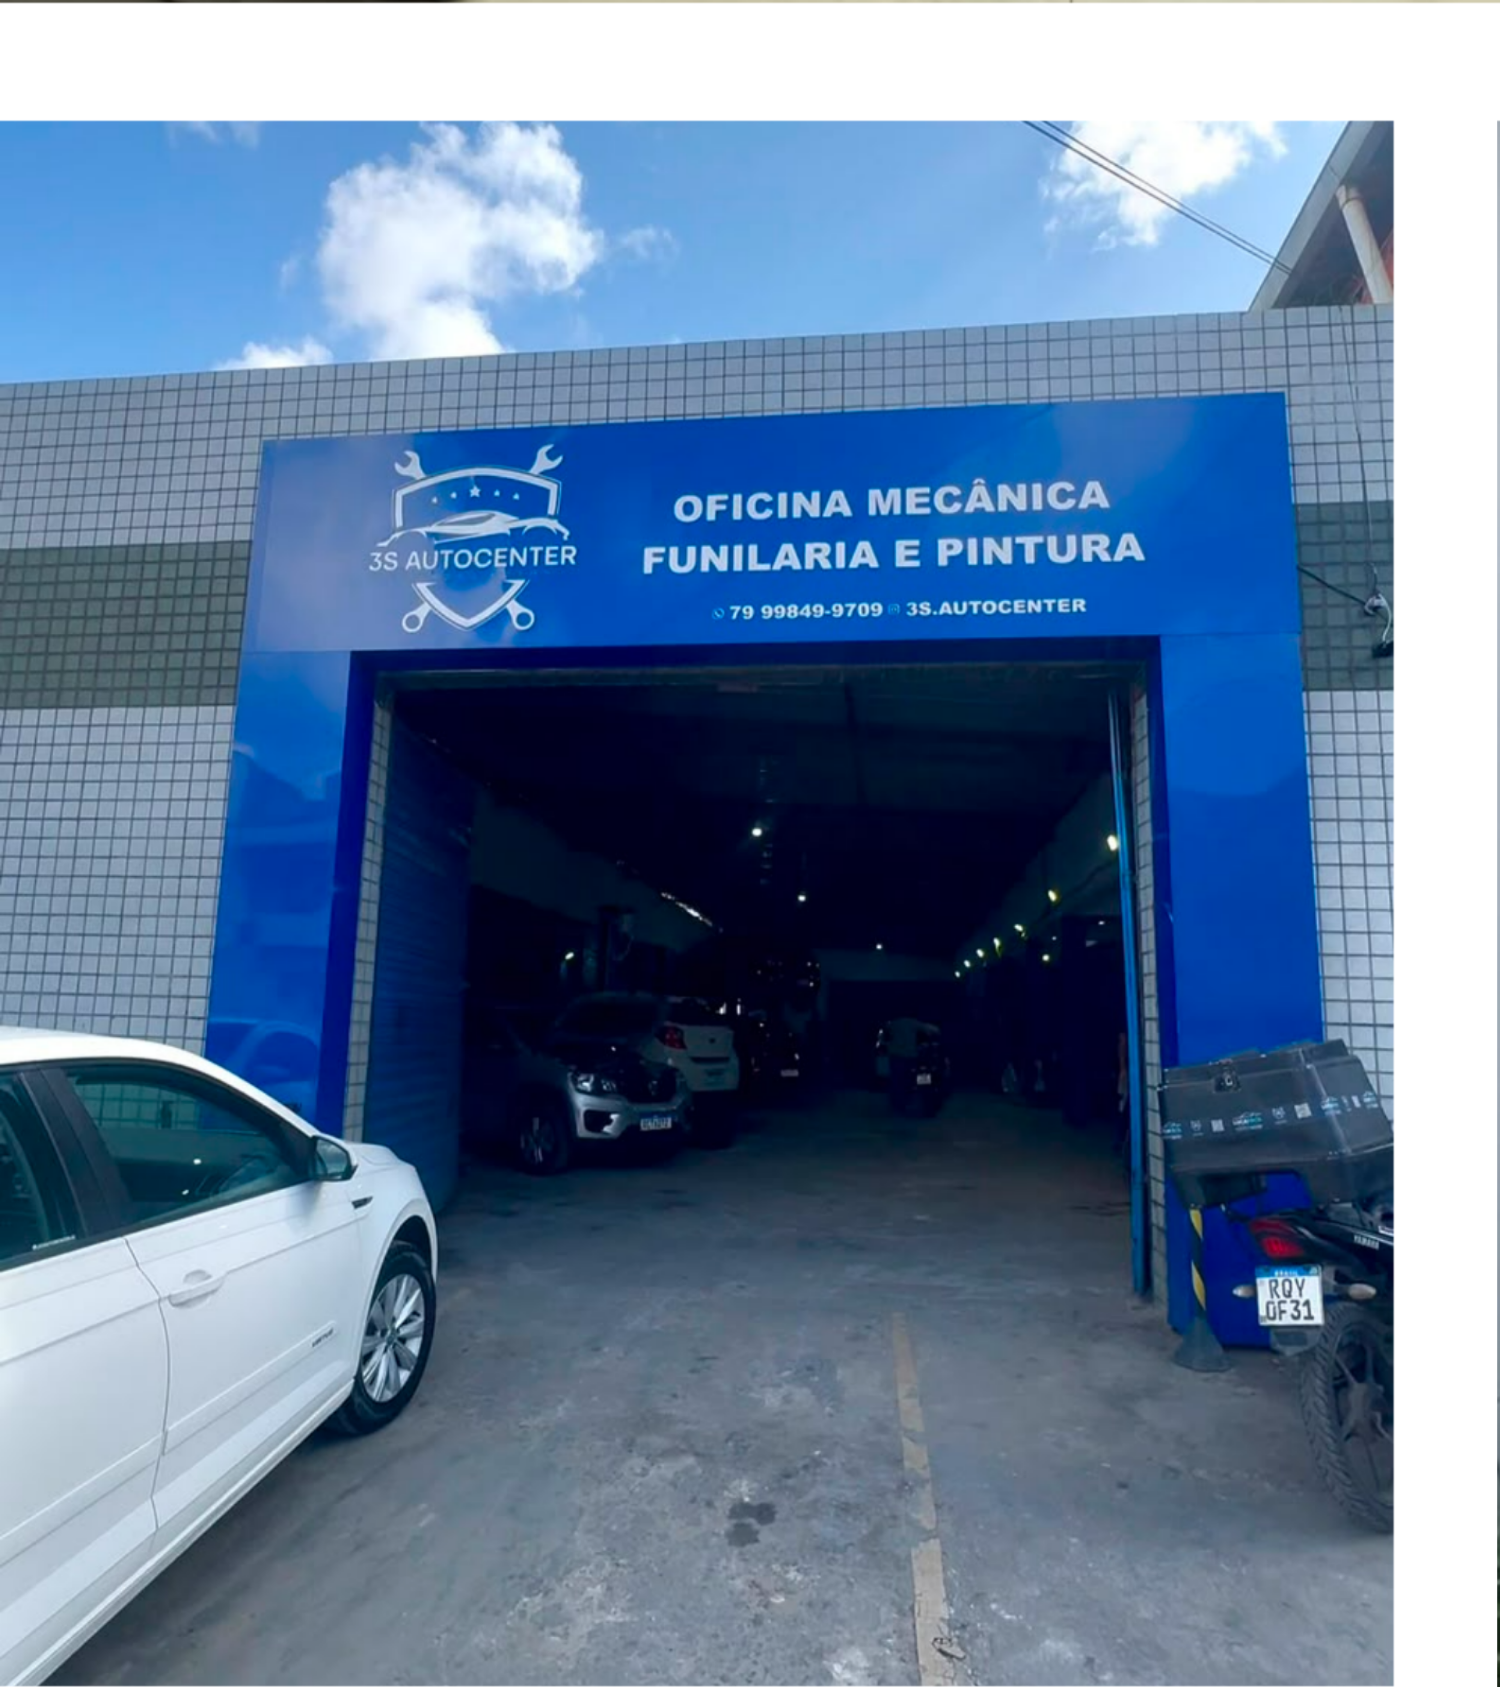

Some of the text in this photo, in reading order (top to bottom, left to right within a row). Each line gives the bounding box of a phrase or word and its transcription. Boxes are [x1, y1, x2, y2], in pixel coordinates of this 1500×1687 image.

[673, 479, 1110, 523] OFICINA MECÂNICA
[368, 545, 578, 572] 3S AUTOCENTER
[643, 533, 1146, 575] FUNILARIA E PINTURA
[730, 599, 1087, 620] 79 99849-9709 3S.AUTOCENTER
[1268, 1278, 1306, 1299] RQY
